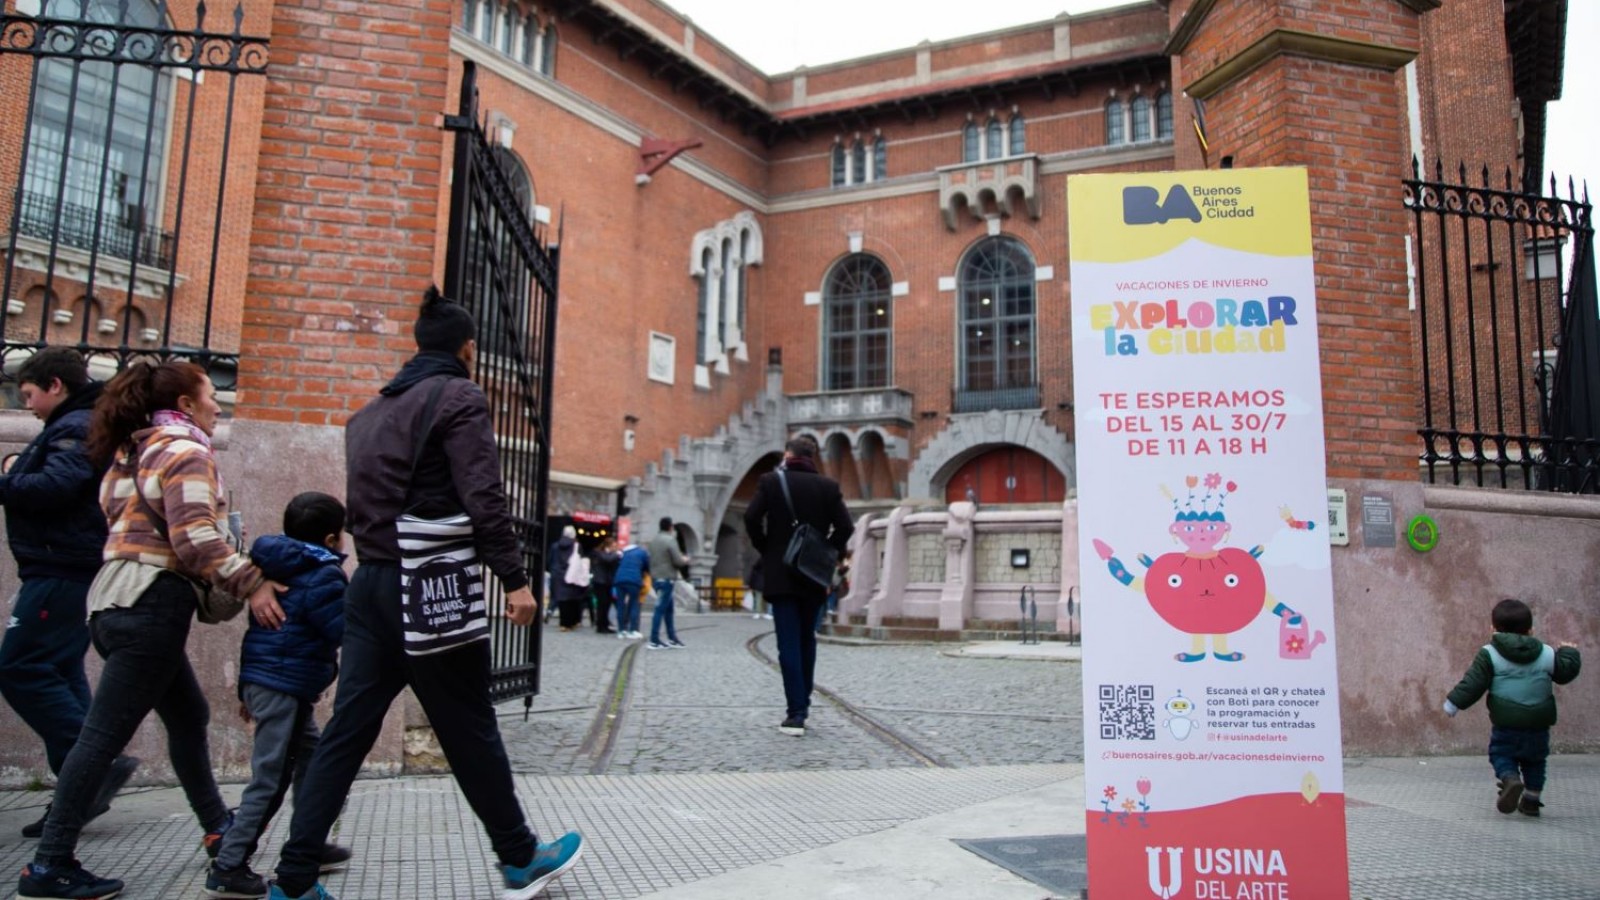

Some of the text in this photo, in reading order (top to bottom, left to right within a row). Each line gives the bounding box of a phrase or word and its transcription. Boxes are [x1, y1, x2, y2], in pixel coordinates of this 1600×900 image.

[1193, 185, 1242, 197] Buenos
[1122, 184, 1202, 226] BA
[1202, 196, 1238, 207] Aires
[1206, 207, 1254, 219] Ciudad
[1116, 278, 1268, 291] VACACIONES DE INVIERNO
[1090, 296, 1298, 331] EXPLORAR
[1104, 326, 1138, 356] la
[1099, 390, 1285, 409] TE ESPERAMOS
[1106, 411, 1287, 433] DEL 15 AL 30/7
[1128, 437, 1267, 456] DE 11 A 18 H
[421, 573, 461, 601] MATE
[422, 604, 431, 615] IS
[1206, 686, 1326, 697] Escaneá el QR y chateá
[1228, 697, 1249, 706] Boti
[1252, 699, 1275, 708] para
[1278, 699, 1319, 707] conocer
[1207, 709, 1300, 719] la programación y
[1207, 720, 1316, 729] reservar tus entradas
[1112, 751, 1325, 763] buenosaires.gob.ar/vacacionesdeinvierno
[1194, 848, 1287, 876] USINA
[1195, 880, 1289, 900] DEL ARTE
